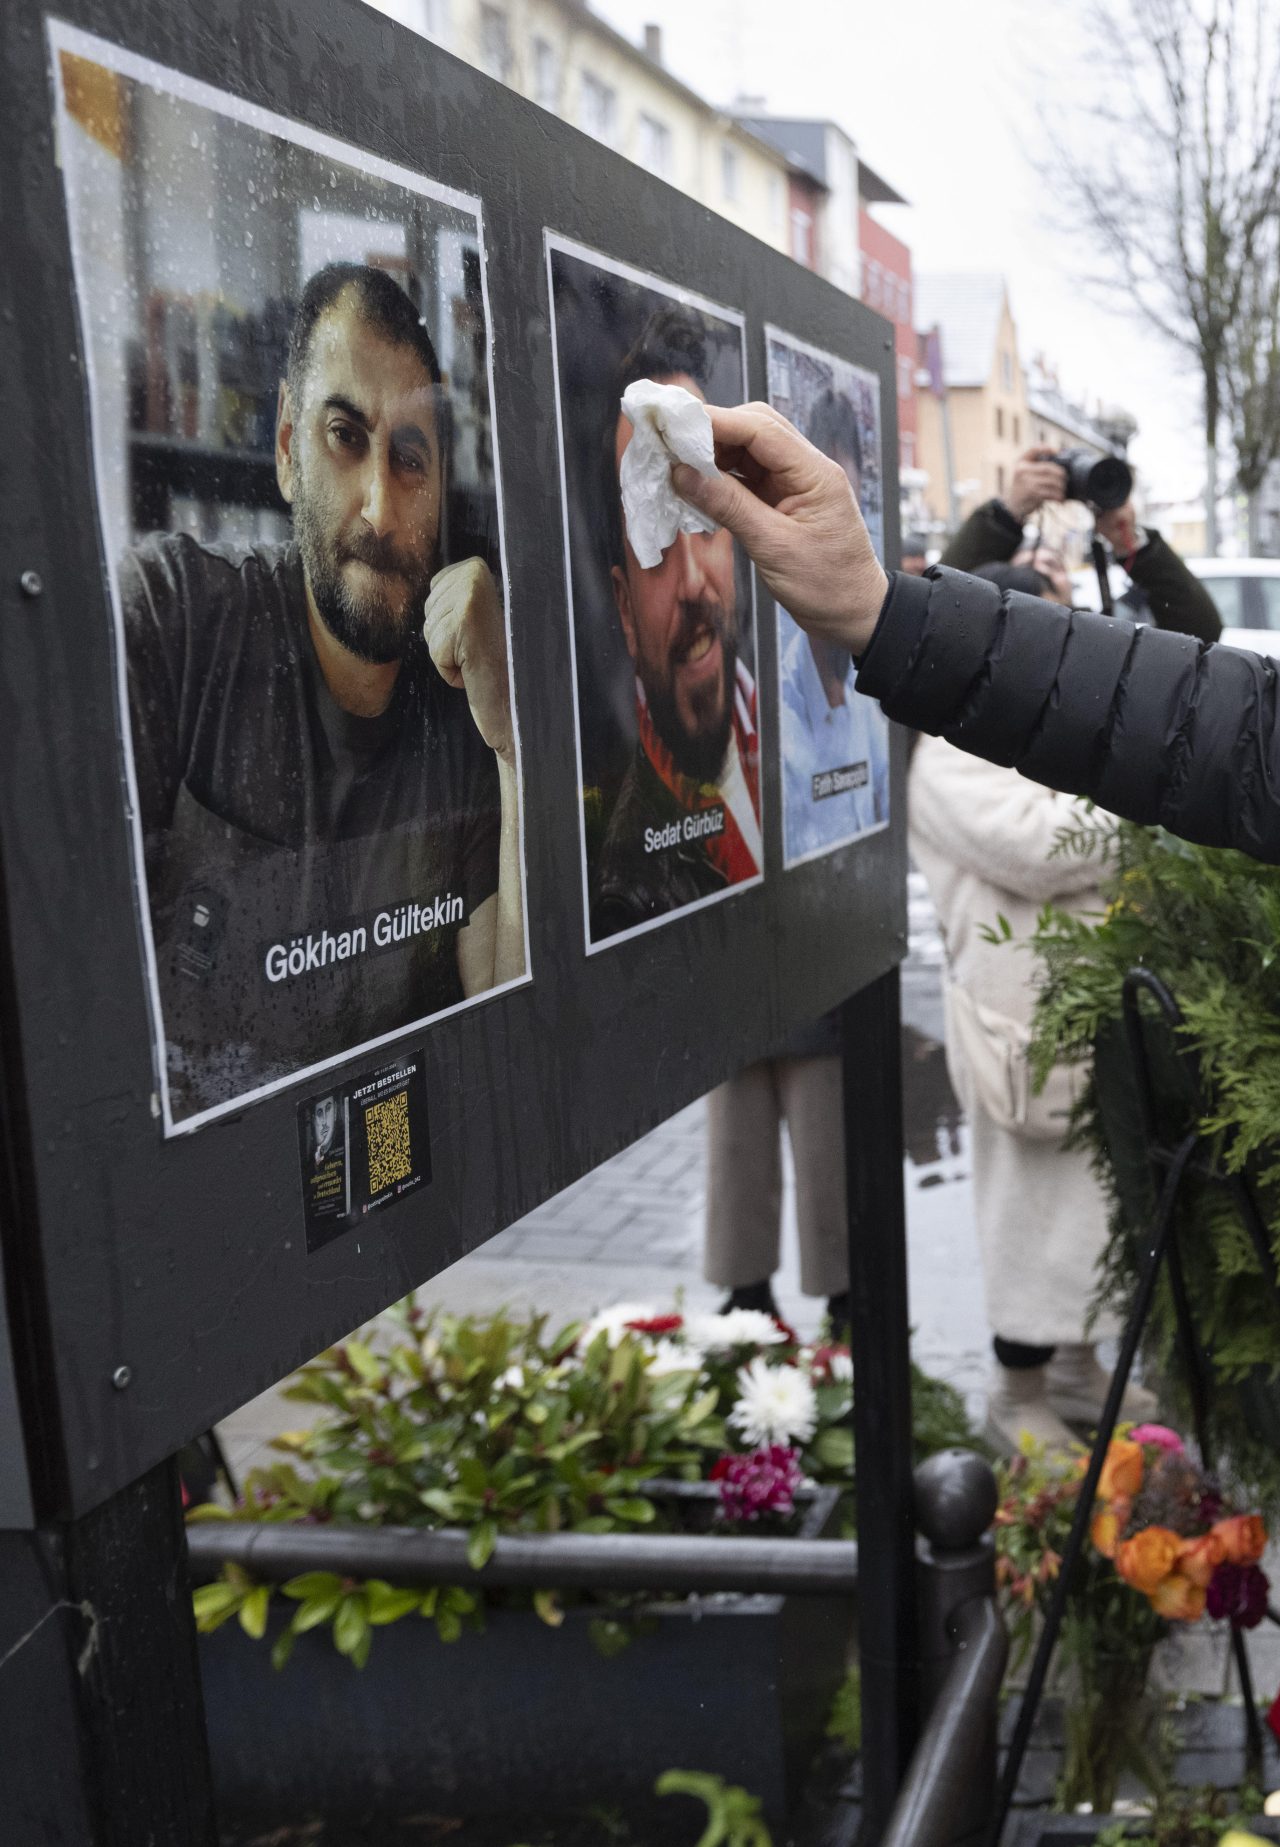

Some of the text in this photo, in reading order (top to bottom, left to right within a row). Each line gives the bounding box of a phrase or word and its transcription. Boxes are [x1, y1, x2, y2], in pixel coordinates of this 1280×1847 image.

[644, 809, 723, 853] Sedat Gürbüz
[265, 927, 367, 982] Gökhan
[373, 893, 463, 946] Gültekin
[353, 1064, 417, 1099] JETZT BESTELLEN
